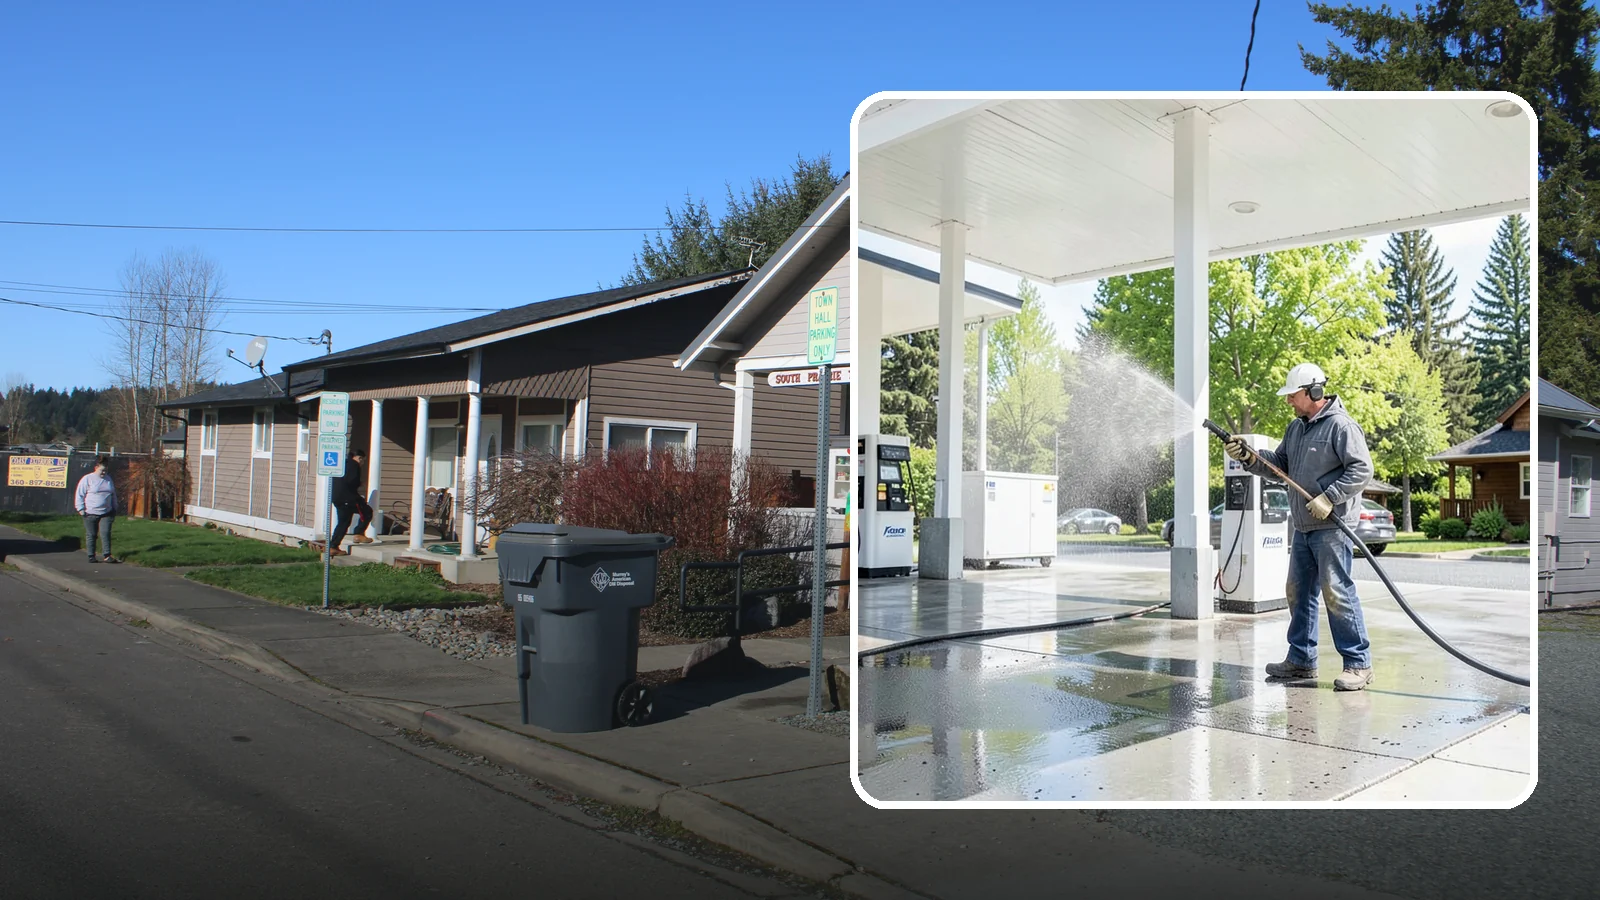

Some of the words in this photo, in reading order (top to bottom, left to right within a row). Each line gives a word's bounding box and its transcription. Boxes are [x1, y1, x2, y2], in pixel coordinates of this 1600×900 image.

[815, 295, 832, 308] TOWN
[814, 312, 831, 324] HALL
[810, 326, 836, 340] PARKING
[814, 344, 830, 356] ONLY
[776, 374, 800, 384] SOUTH
